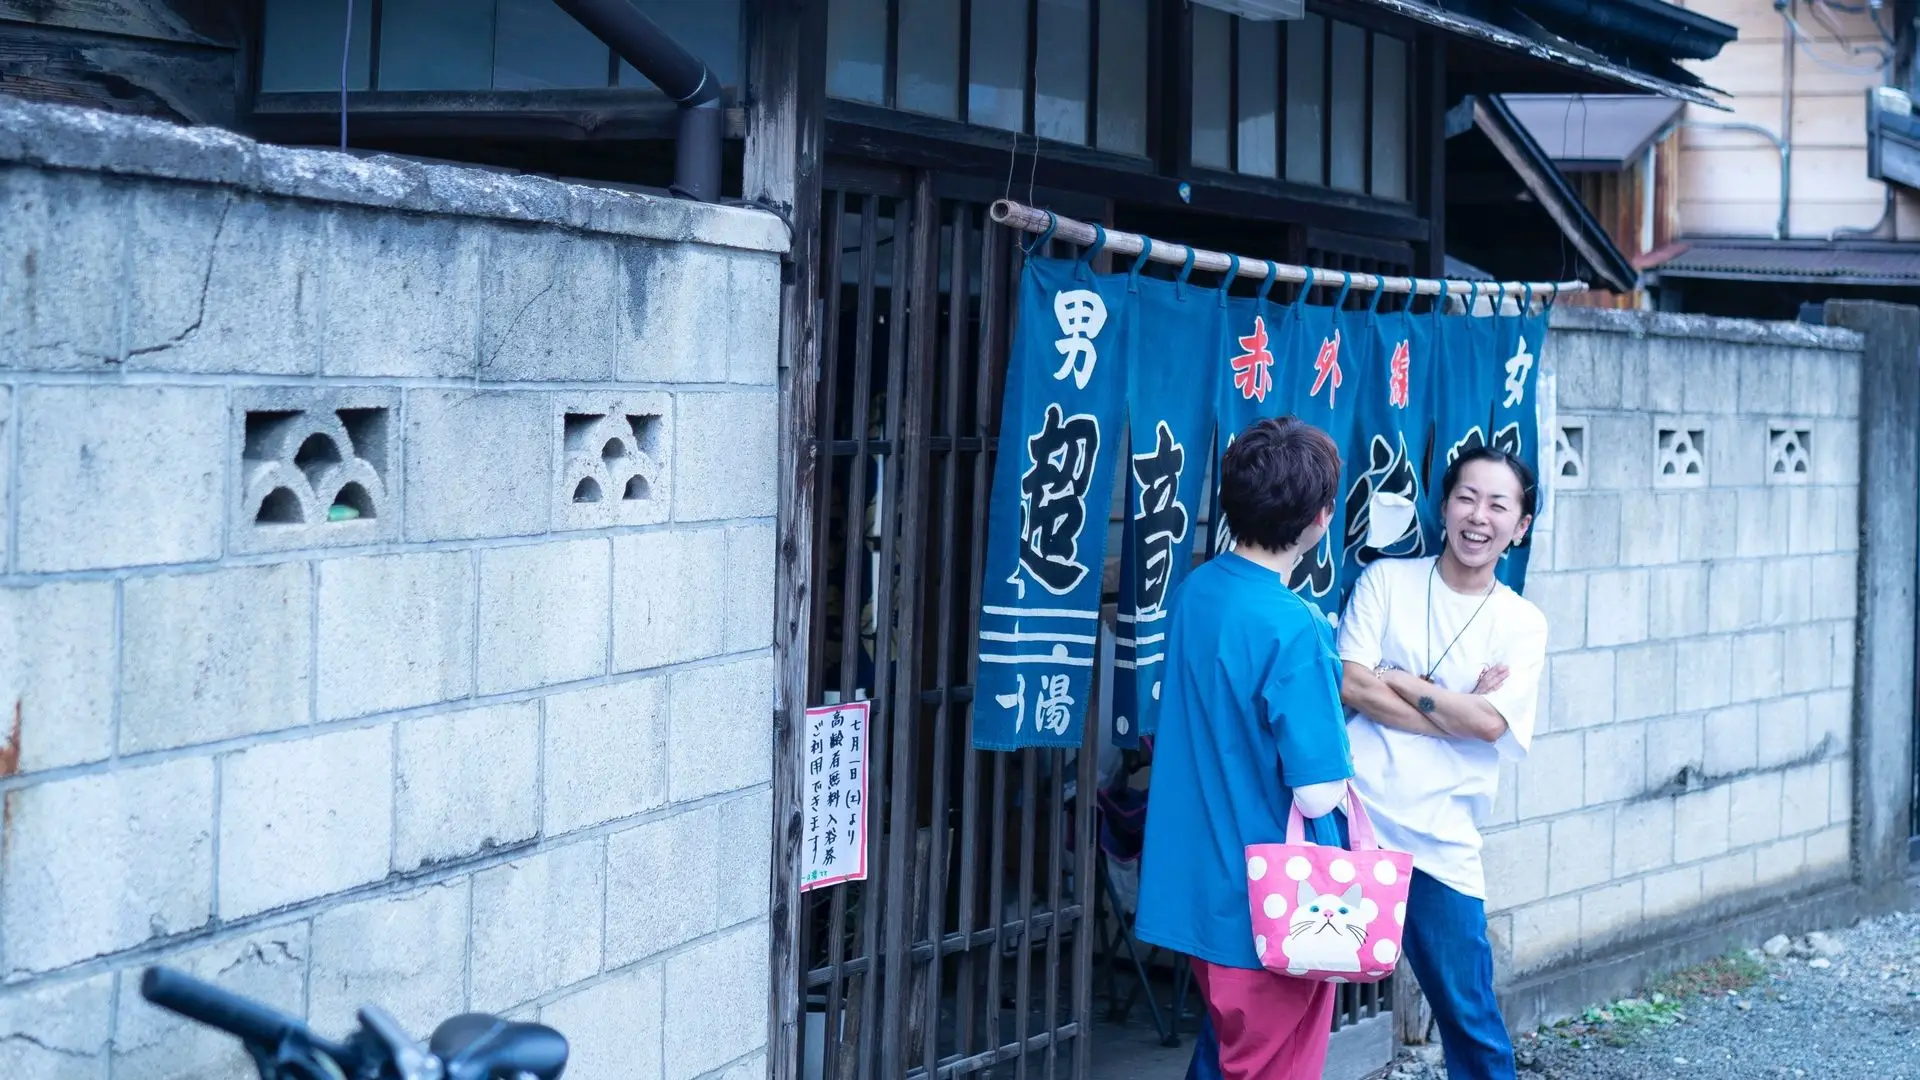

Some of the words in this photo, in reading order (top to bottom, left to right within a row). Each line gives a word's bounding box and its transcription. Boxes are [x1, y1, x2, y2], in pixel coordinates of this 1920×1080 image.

[1053, 289, 1108, 390] 男
[1503, 335, 1534, 409] 女
[807, 719, 824, 865] ご利用できます
